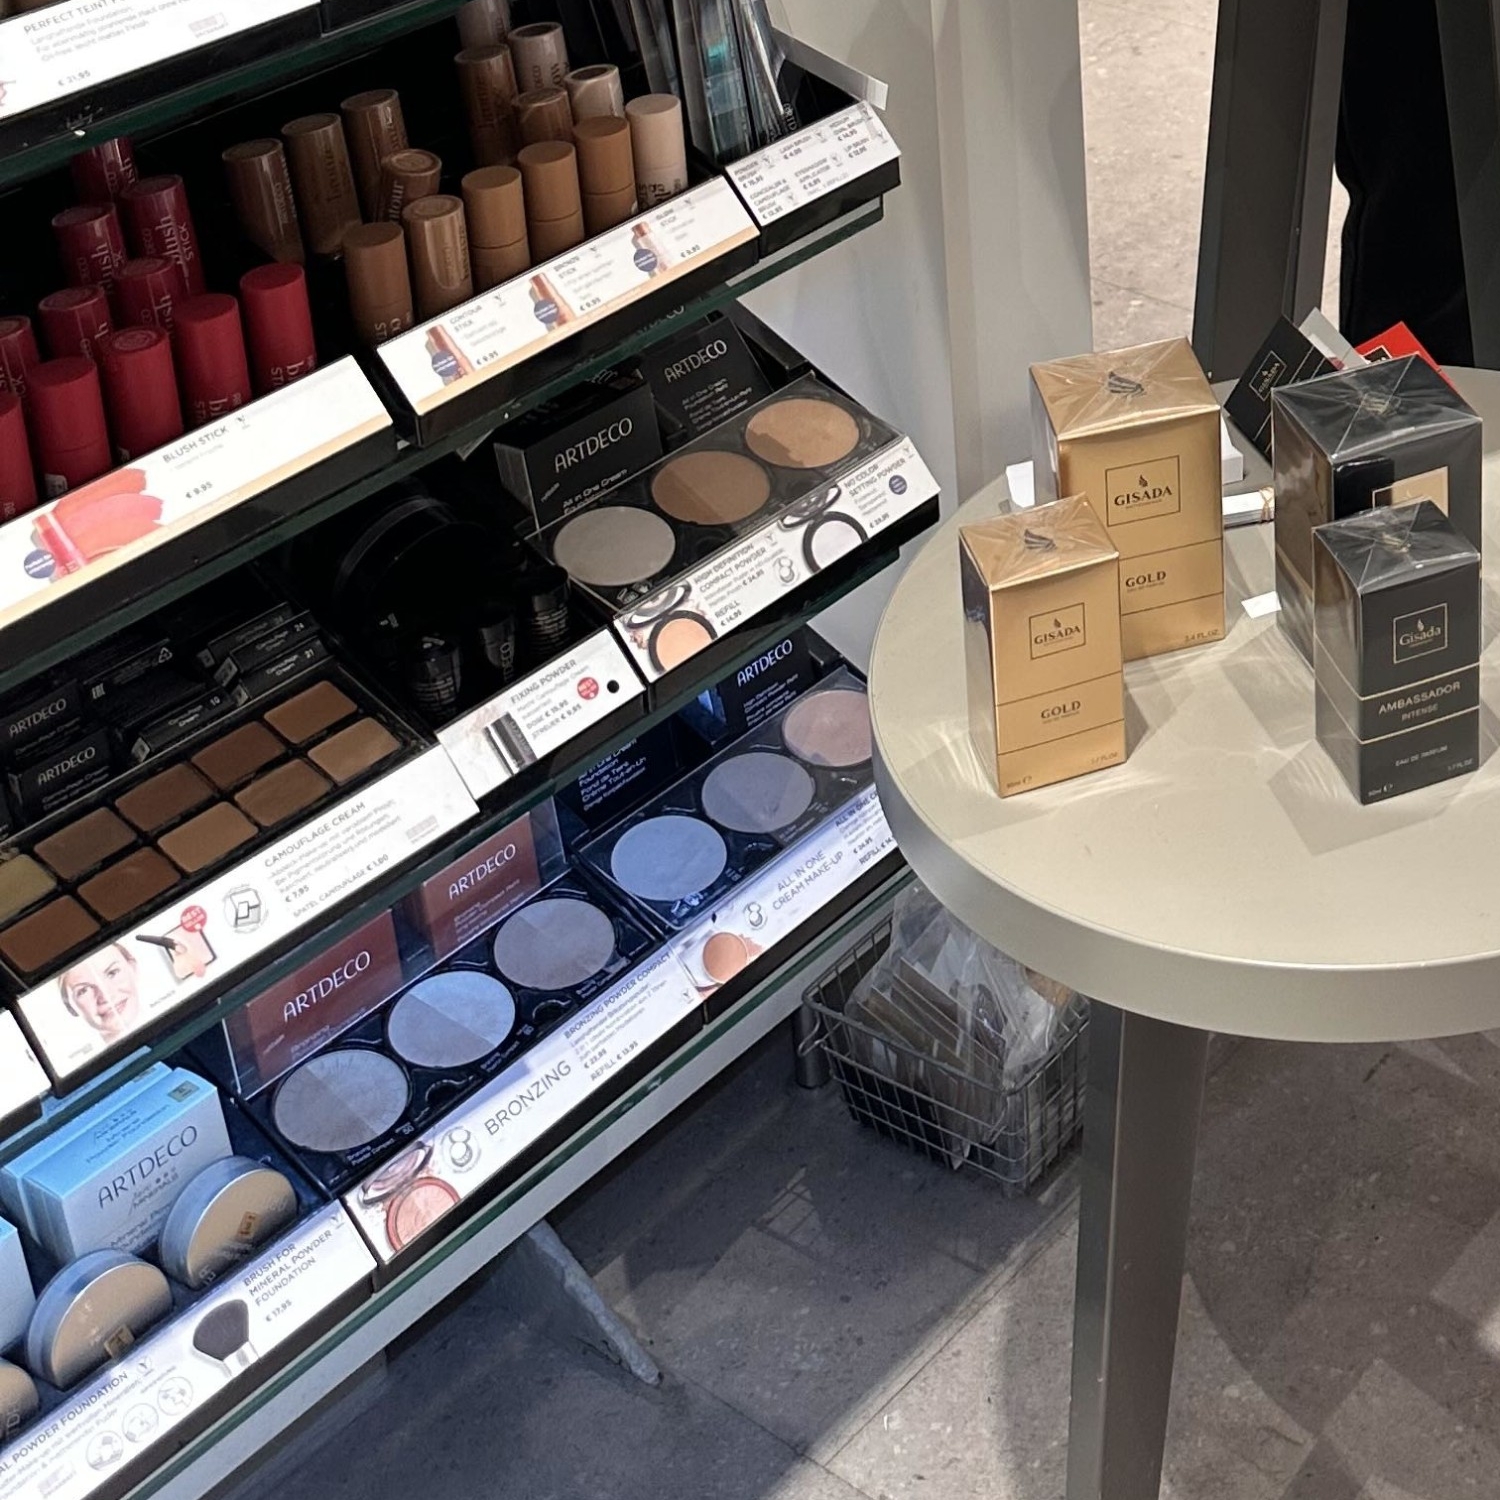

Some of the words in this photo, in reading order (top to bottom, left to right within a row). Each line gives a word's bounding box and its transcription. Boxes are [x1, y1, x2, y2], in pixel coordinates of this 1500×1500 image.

[23, 9, 74, 35] PERFECT
[450, 304, 484, 325] CONTOUR
[453, 318, 475, 333] STICK
[663, 338, 728, 384] ARTDECO
[161, 439, 198, 465] BLUSH
[198, 424, 230, 448] STICK
[553, 416, 634, 474] ARTDECO
[848, 479, 878, 498] SETTING
[877, 457, 907, 483] POWDER
[1113, 485, 1173, 507] GISADA
[693, 571, 713, 585] HIGH
[712, 543, 756, 573] DEFINITION
[699, 571, 736, 594] COMPACT
[734, 546, 768, 573] POWDER
[1125, 570, 1167, 588] GOLD
[714, 600, 742, 619] REFILL
[1033, 624, 1082, 646] GISADA
[1399, 625, 1442, 647] Gisada
[510, 680, 541, 704] FIXING
[540, 658, 578, 686] POWDER
[737, 638, 794, 688] ARTDECO
[8, 697, 68, 739] ARTDECO
[1040, 700, 1082, 720] GOLD
[1378, 681, 1462, 716] AMBASSADOR
[1400, 702, 1440, 722] INTENSE
[36, 745, 97, 788] ARTDECO
[264, 823, 332, 869] CAMOUFLAGE
[331, 801, 367, 828] CREAM
[447, 842, 518, 901] ARTDECO
[771, 884, 804, 912] CREAM
[801, 850, 845, 891] MAKE-UP
[776, 874, 797, 894] ALL
[796, 866, 807, 881] IN
[804, 849, 828, 873] ONE
[282, 949, 373, 1023] ARTDECO
[563, 1002, 606, 1040] BRONZING
[603, 978, 639, 1009] POWDER
[635, 950, 673, 985] COMPACT
[590, 1057, 618, 1082] REFILL
[483, 1059, 573, 1137] BRONZING
[97, 1124, 199, 1210] ARTDECO
[242, 1254, 274, 1288] BRUSH
[272, 1241, 299, 1265] FOR
[248, 1259, 292, 1300] MINERAL
[289, 1228, 334, 1269] POWDER
[254, 1258, 318, 1308] FOUNDATION
[11, 1417, 61, 1467] POWDER
[59, 1370, 130, 1429] FOUNDATION
